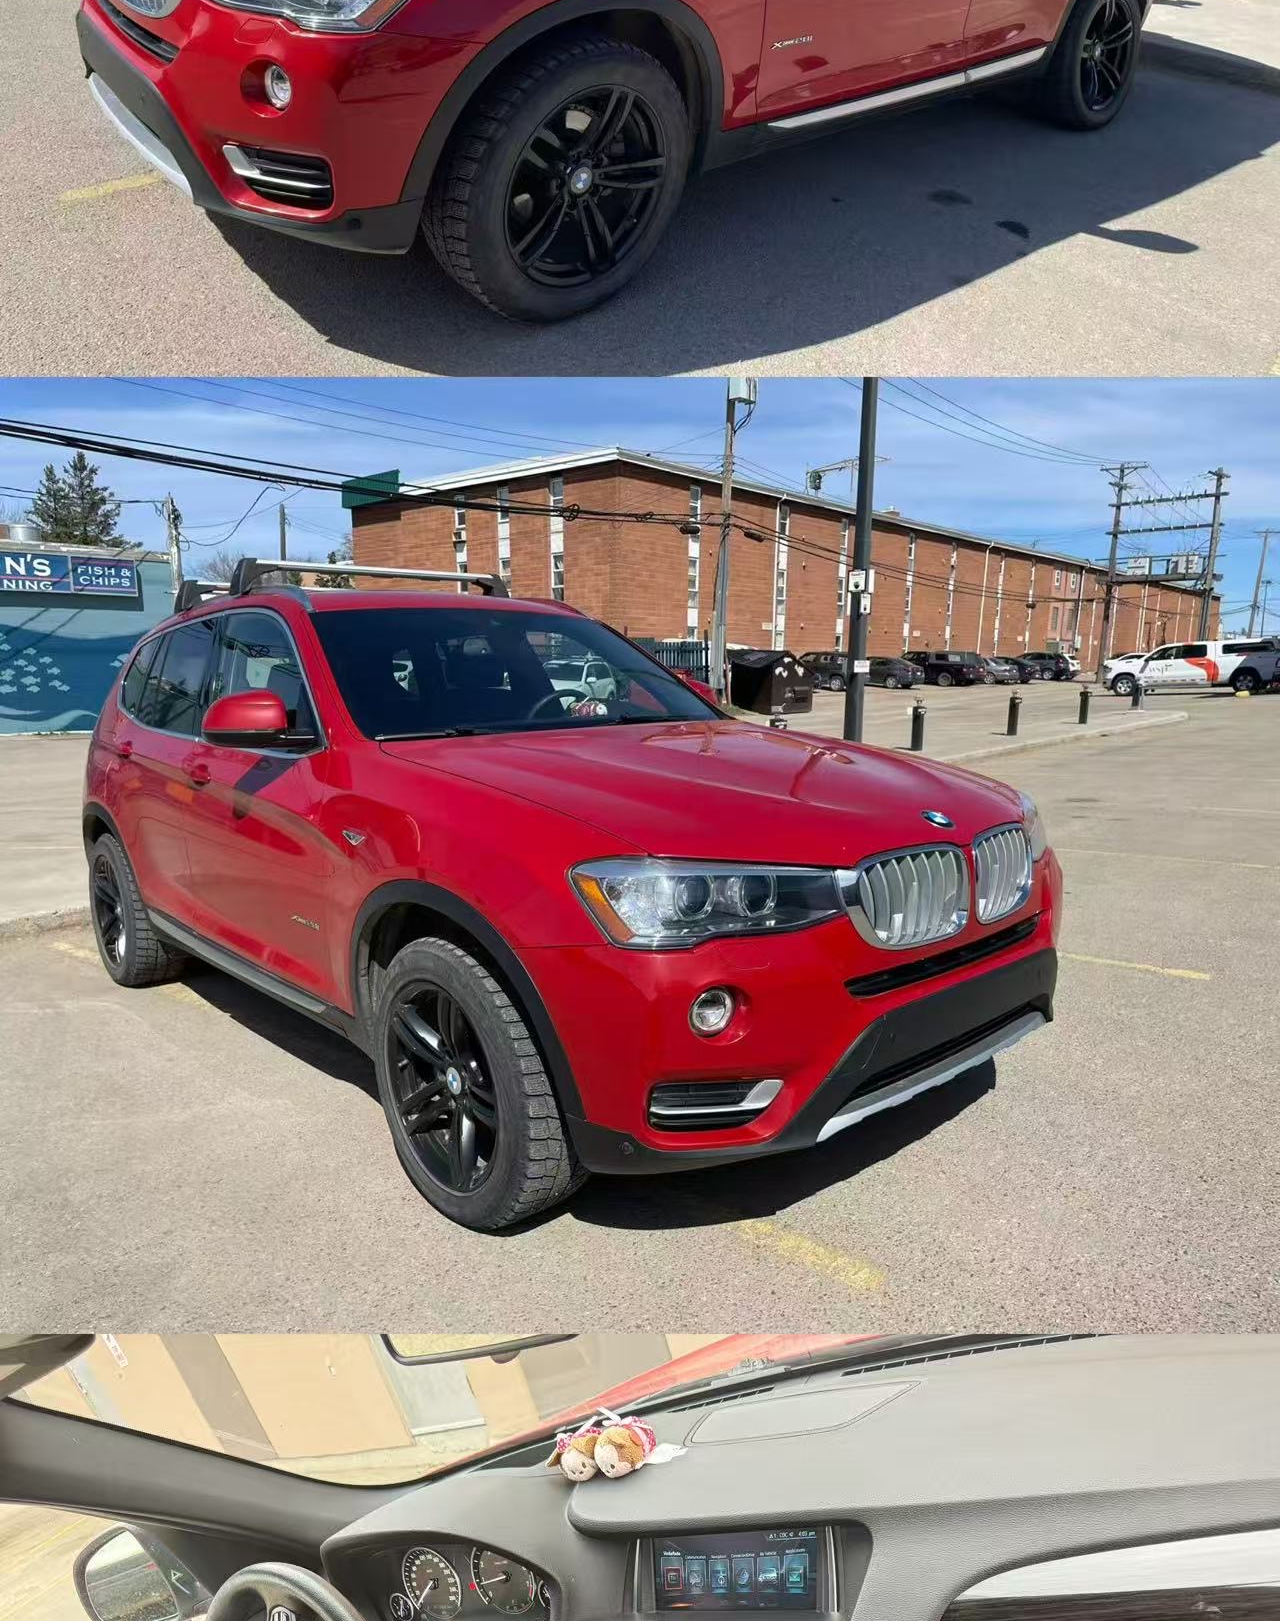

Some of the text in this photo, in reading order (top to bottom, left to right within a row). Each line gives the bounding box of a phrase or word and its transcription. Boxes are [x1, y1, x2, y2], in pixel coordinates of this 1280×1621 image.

[0, 554, 51, 577] N'S
[77, 565, 131, 577] FISH &
[0, 579, 53, 591] NING
[79, 575, 131, 587] CHIPS
